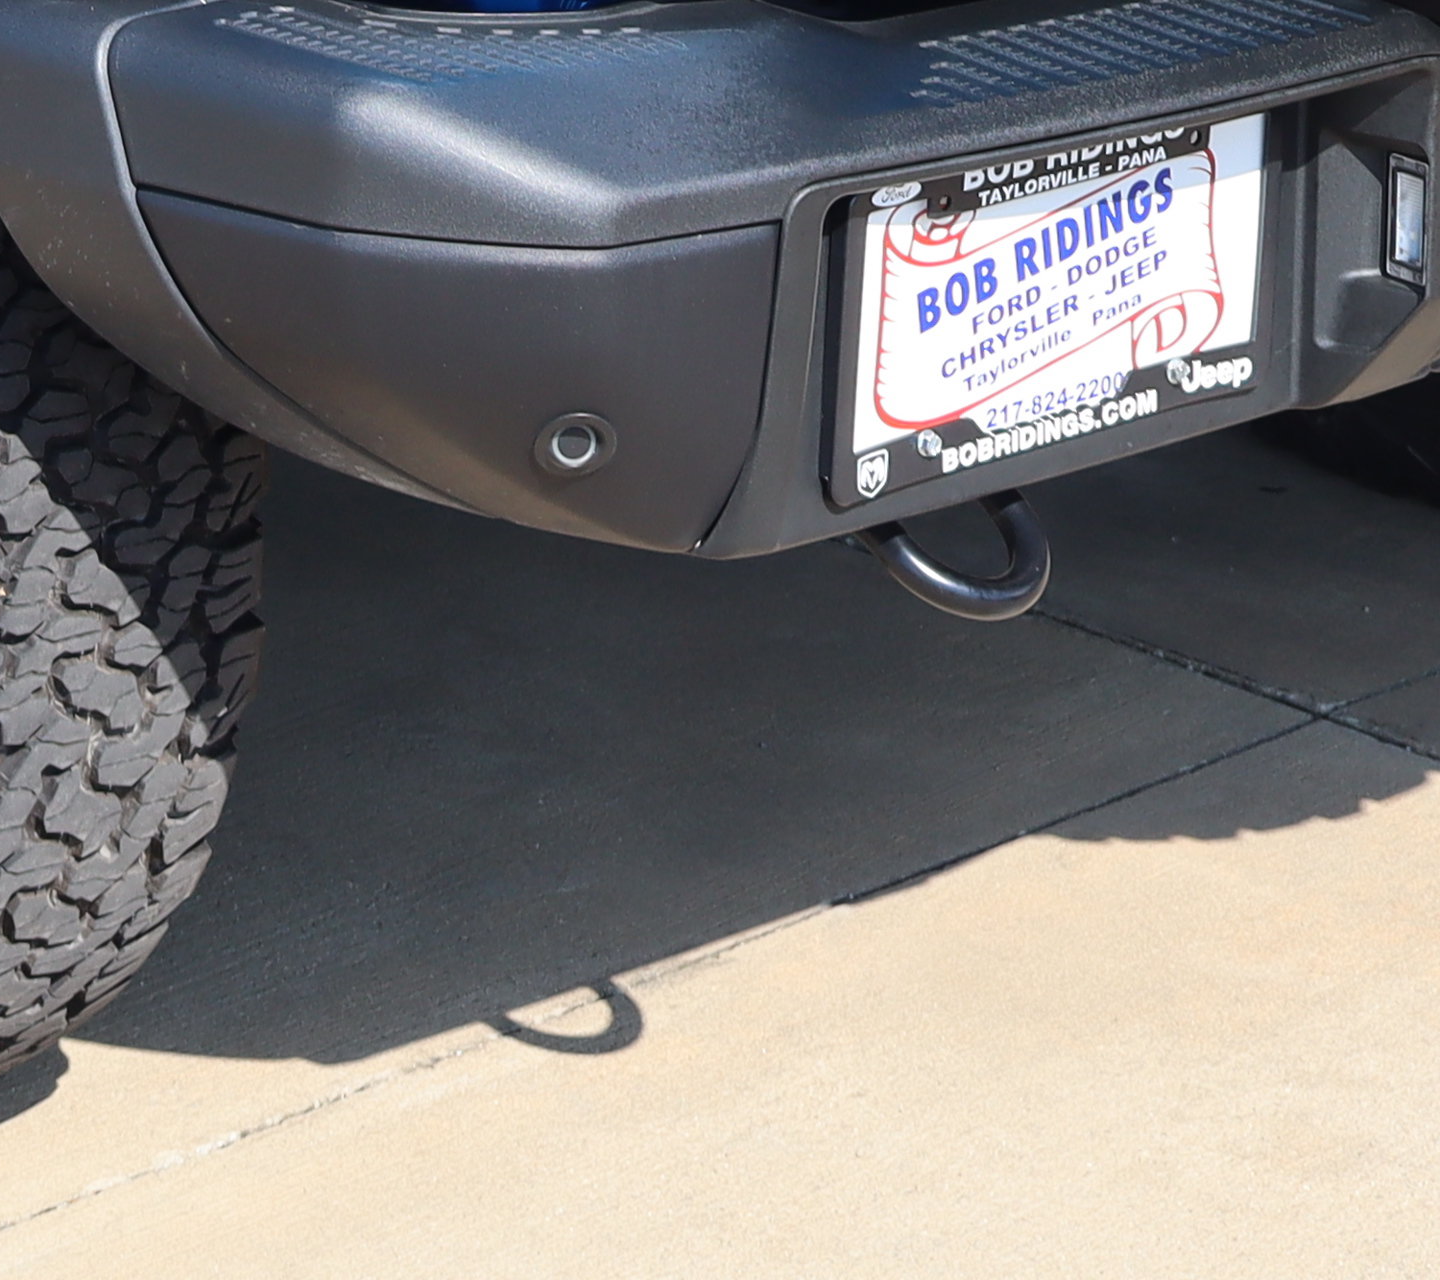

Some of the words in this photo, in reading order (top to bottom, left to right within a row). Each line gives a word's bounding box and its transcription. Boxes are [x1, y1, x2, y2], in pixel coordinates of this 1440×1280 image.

[978, 162, 1100, 207] TAYLORVILLE
[1118, 146, 1166, 172] PANA
[916, 257, 998, 334] BOB
[1013, 167, 1174, 283] RIDINGS
[971, 286, 1041, 334] FORD
[1067, 227, 1158, 286] DODGE
[941, 295, 1079, 378] CHRYSLER
[1105, 250, 1169, 296] JEEP
[963, 328, 1071, 392] Taylorville
[1092, 294, 1143, 327] Pana
[986, 371, 1128, 428] 217-824-2200
[1182, 355, 1253, 392] Jeep
[941, 388, 1158, 475] BOBRIDINGS.COM
